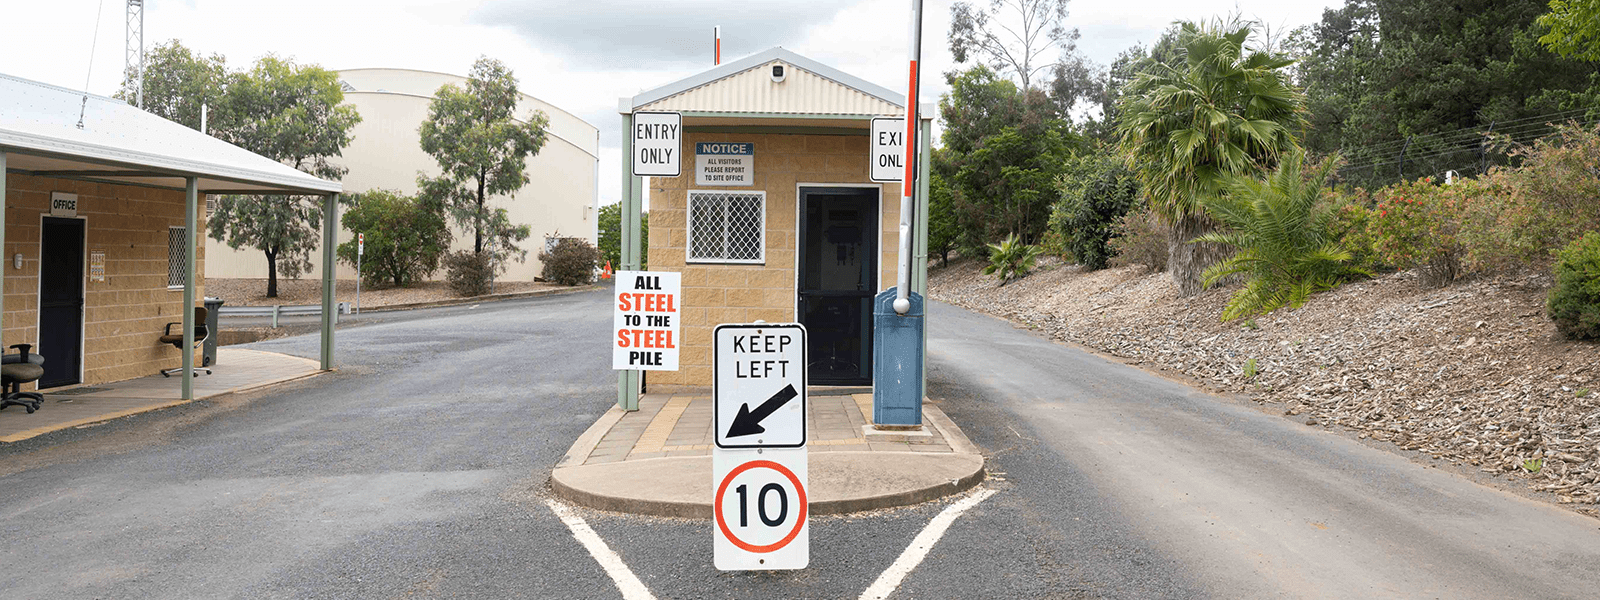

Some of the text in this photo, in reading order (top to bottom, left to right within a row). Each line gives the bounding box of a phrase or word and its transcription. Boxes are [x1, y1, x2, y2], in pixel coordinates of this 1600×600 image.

[637, 123, 678, 140] ENTRY
[878, 131, 902, 146] EXI
[641, 147, 673, 164] ONLY
[702, 144, 747, 154] NOTICE
[878, 154, 903, 168] ONL
[53, 199, 76, 210] OFFICE
[634, 275, 662, 290] ALL
[618, 292, 676, 312] STEEL
[624, 314, 670, 327] TO THE
[617, 328, 675, 349] STEEL
[733, 335, 792, 353] KEEP
[629, 351, 663, 366] PILE
[736, 360, 789, 378] LEFT
[735, 482, 788, 527] 10
